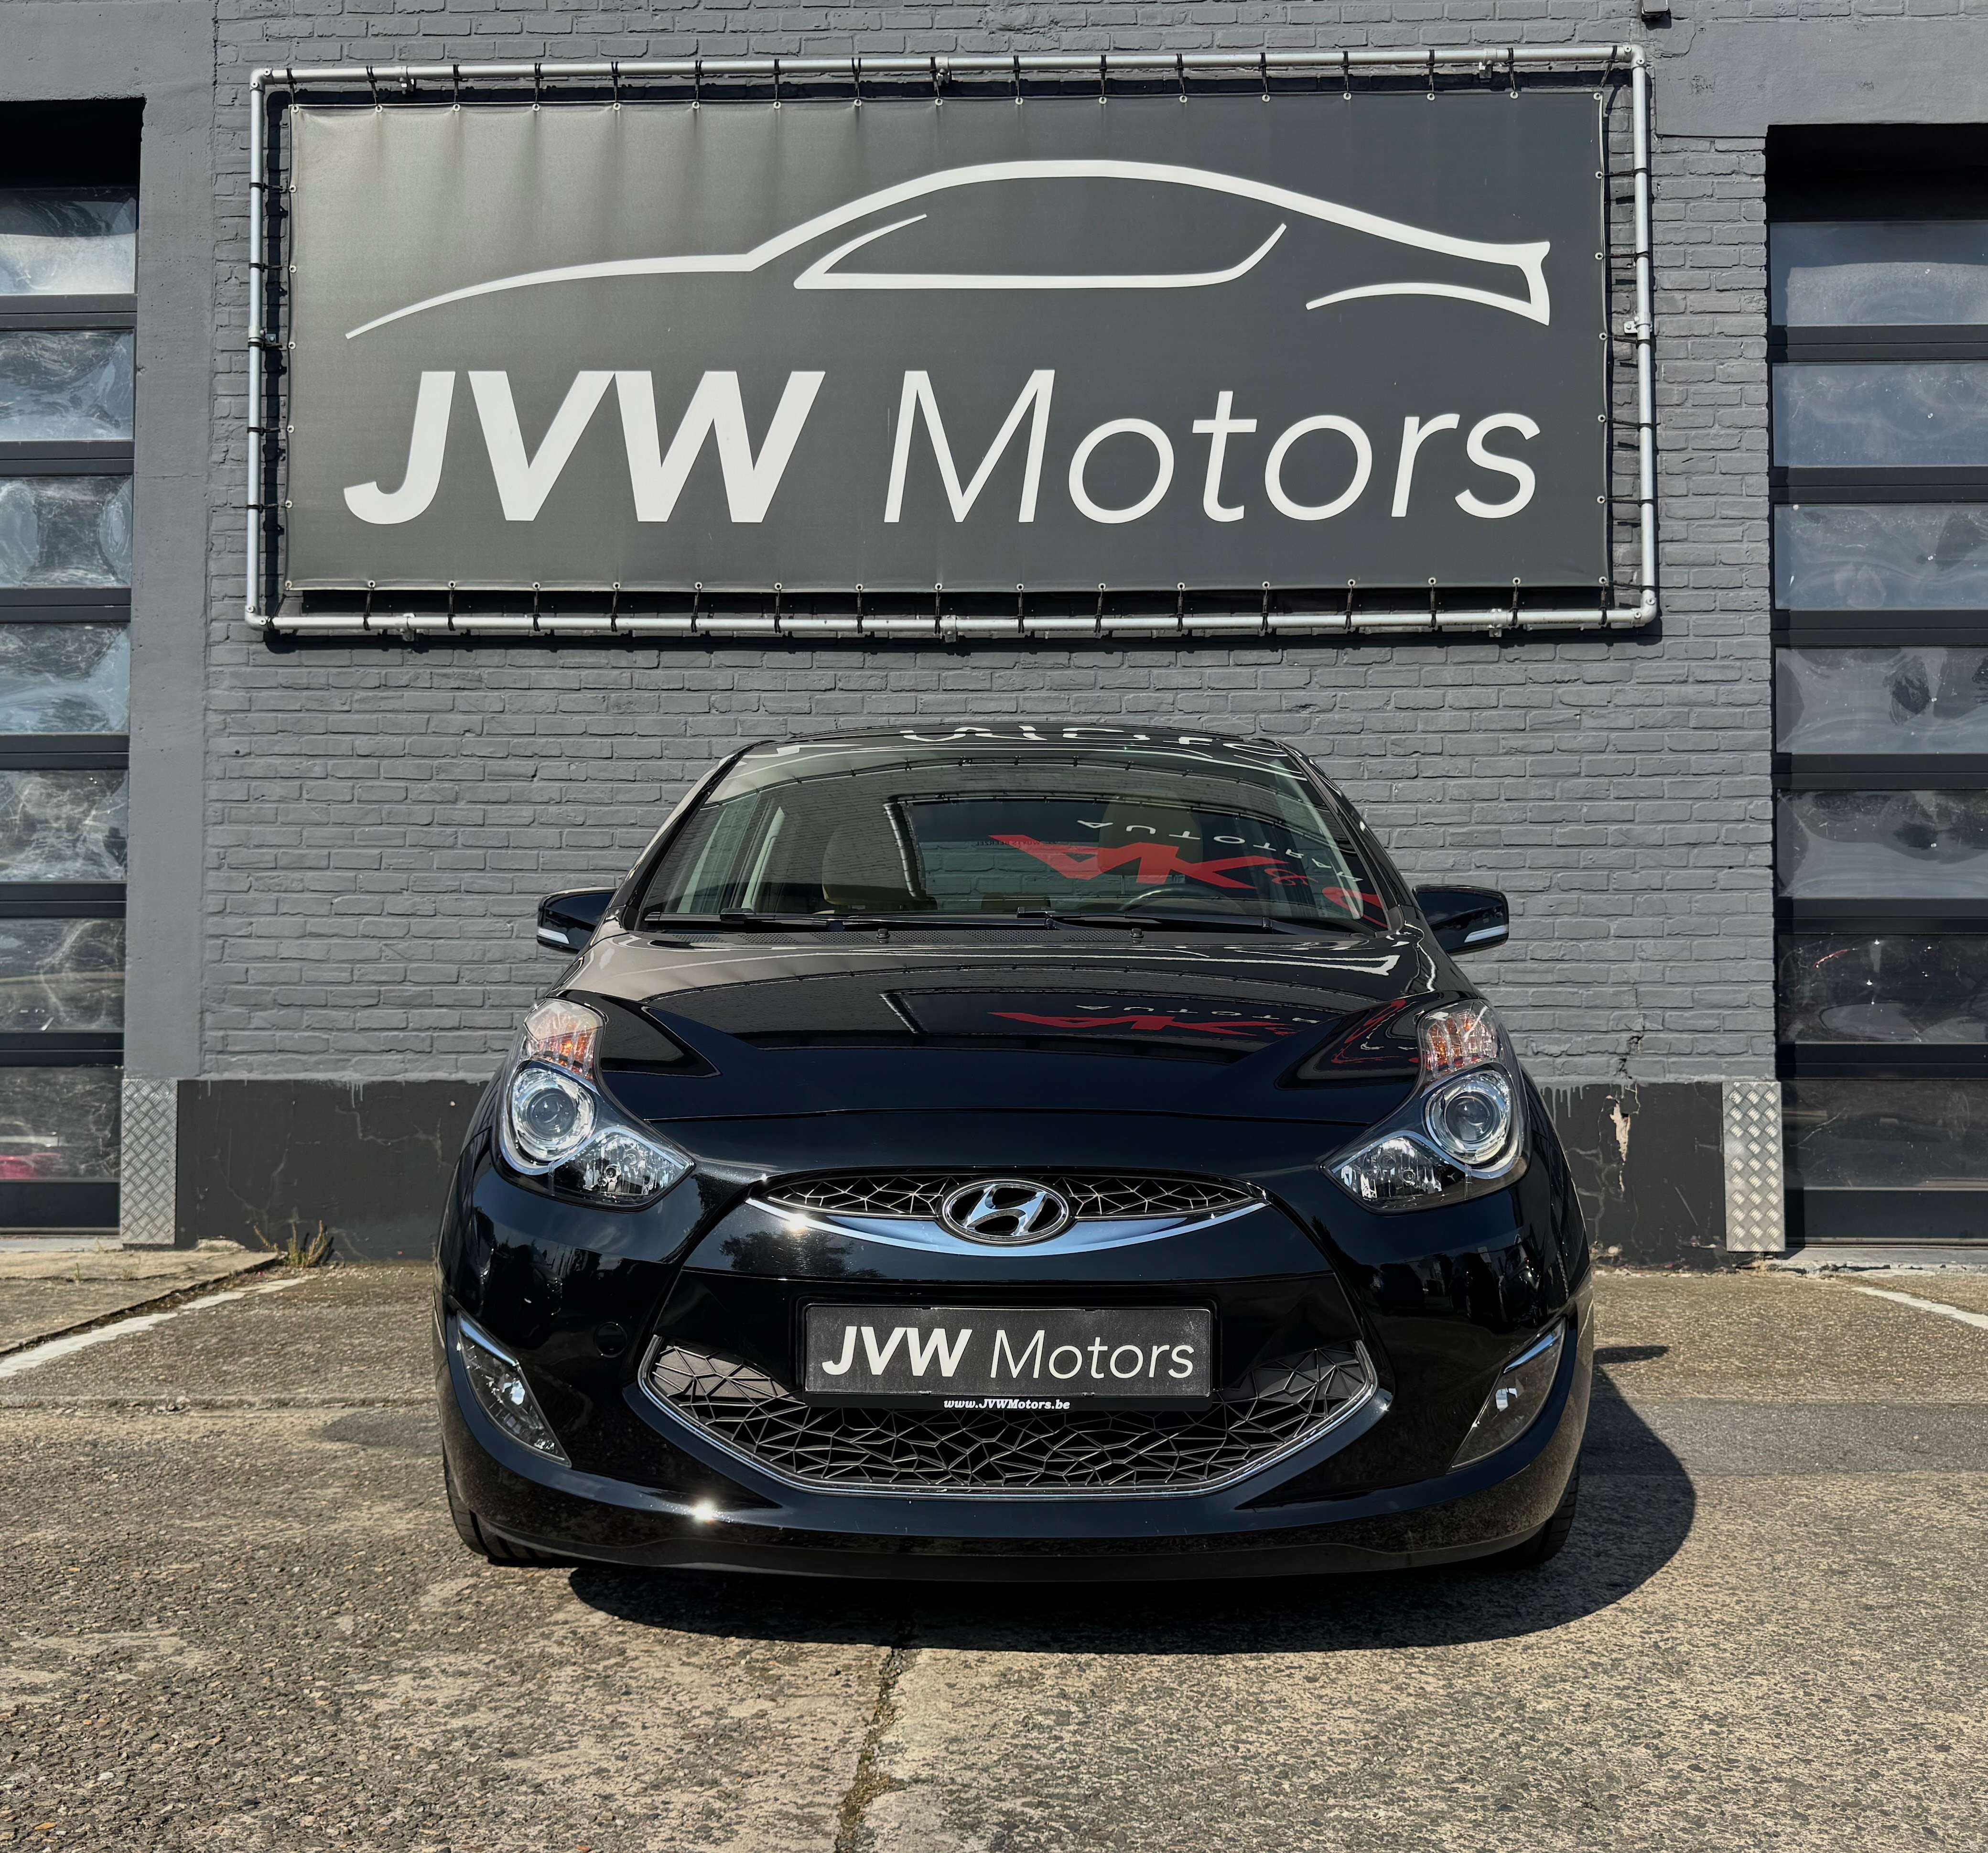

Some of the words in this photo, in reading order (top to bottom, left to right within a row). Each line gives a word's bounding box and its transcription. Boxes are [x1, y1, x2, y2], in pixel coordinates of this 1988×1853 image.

[344, 370, 826, 524] JVW
[884, 369, 1540, 524] Motors
[821, 1326, 972, 1377] JVW
[990, 1329, 1194, 1379] Motors
[943, 1398, 1070, 1409] www.JVWMotors.be
